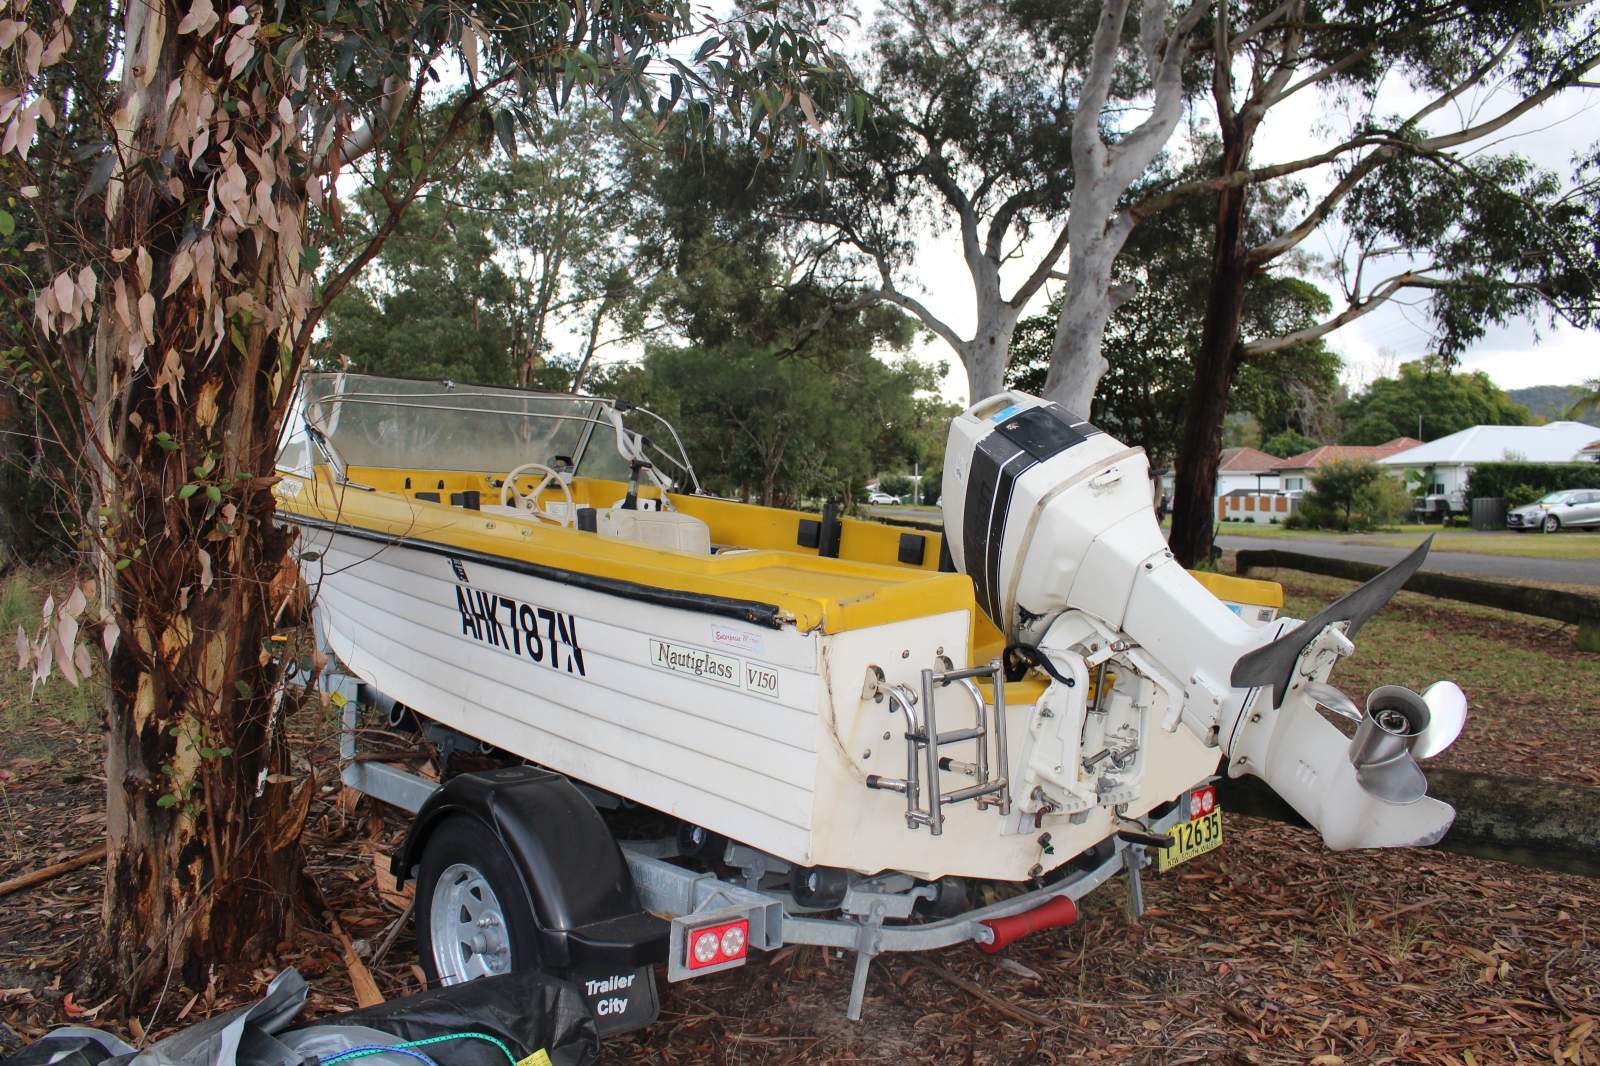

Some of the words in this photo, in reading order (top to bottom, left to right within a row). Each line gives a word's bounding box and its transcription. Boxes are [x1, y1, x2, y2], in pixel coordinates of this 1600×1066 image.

[456, 584, 586, 677] AHK787N
[658, 643, 734, 676] Nautiglass
[748, 669, 777, 691] V150
[585, 974, 636, 996] Trailer
[597, 997, 628, 1016] City
